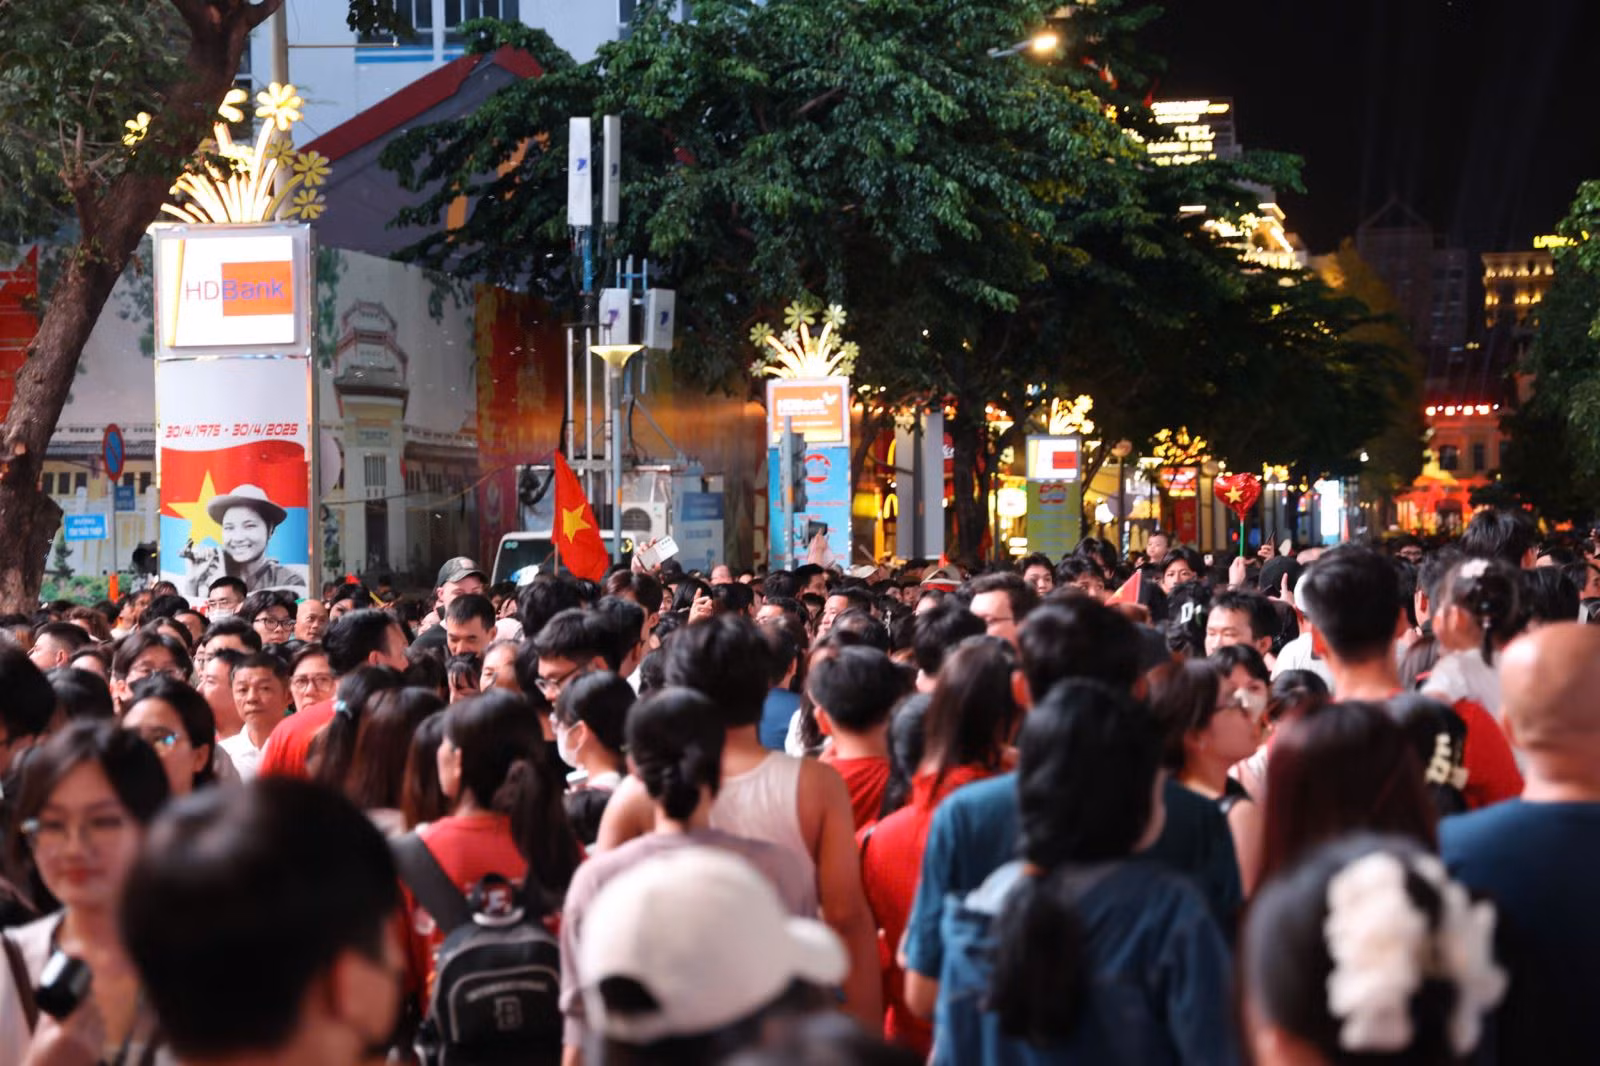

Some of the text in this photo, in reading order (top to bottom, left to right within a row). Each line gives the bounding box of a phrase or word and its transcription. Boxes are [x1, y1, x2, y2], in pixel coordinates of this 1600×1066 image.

[185, 278, 285, 300] HDBank
[165, 424, 221, 438] 30/4/1975
[232, 422, 299, 436] 30/4/2025
